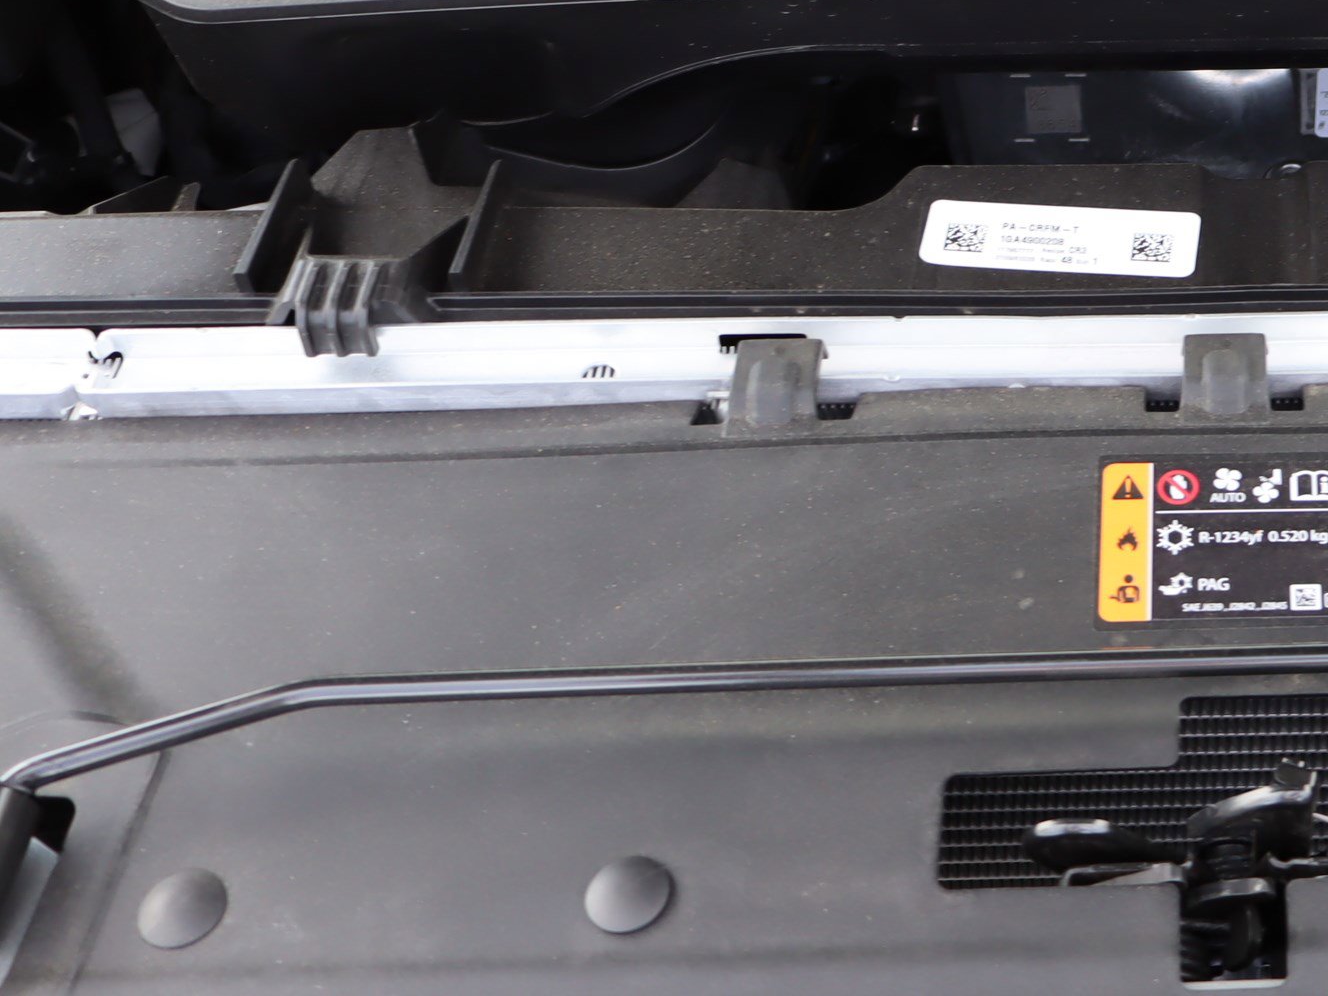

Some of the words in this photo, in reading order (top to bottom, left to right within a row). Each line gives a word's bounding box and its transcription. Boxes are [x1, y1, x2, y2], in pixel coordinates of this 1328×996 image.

[1209, 492, 1246, 503] AUTO
[1198, 529, 1264, 545] R-1234yf
[1268, 529, 1309, 543] 0.520
[1197, 578, 1230, 591] PAG
